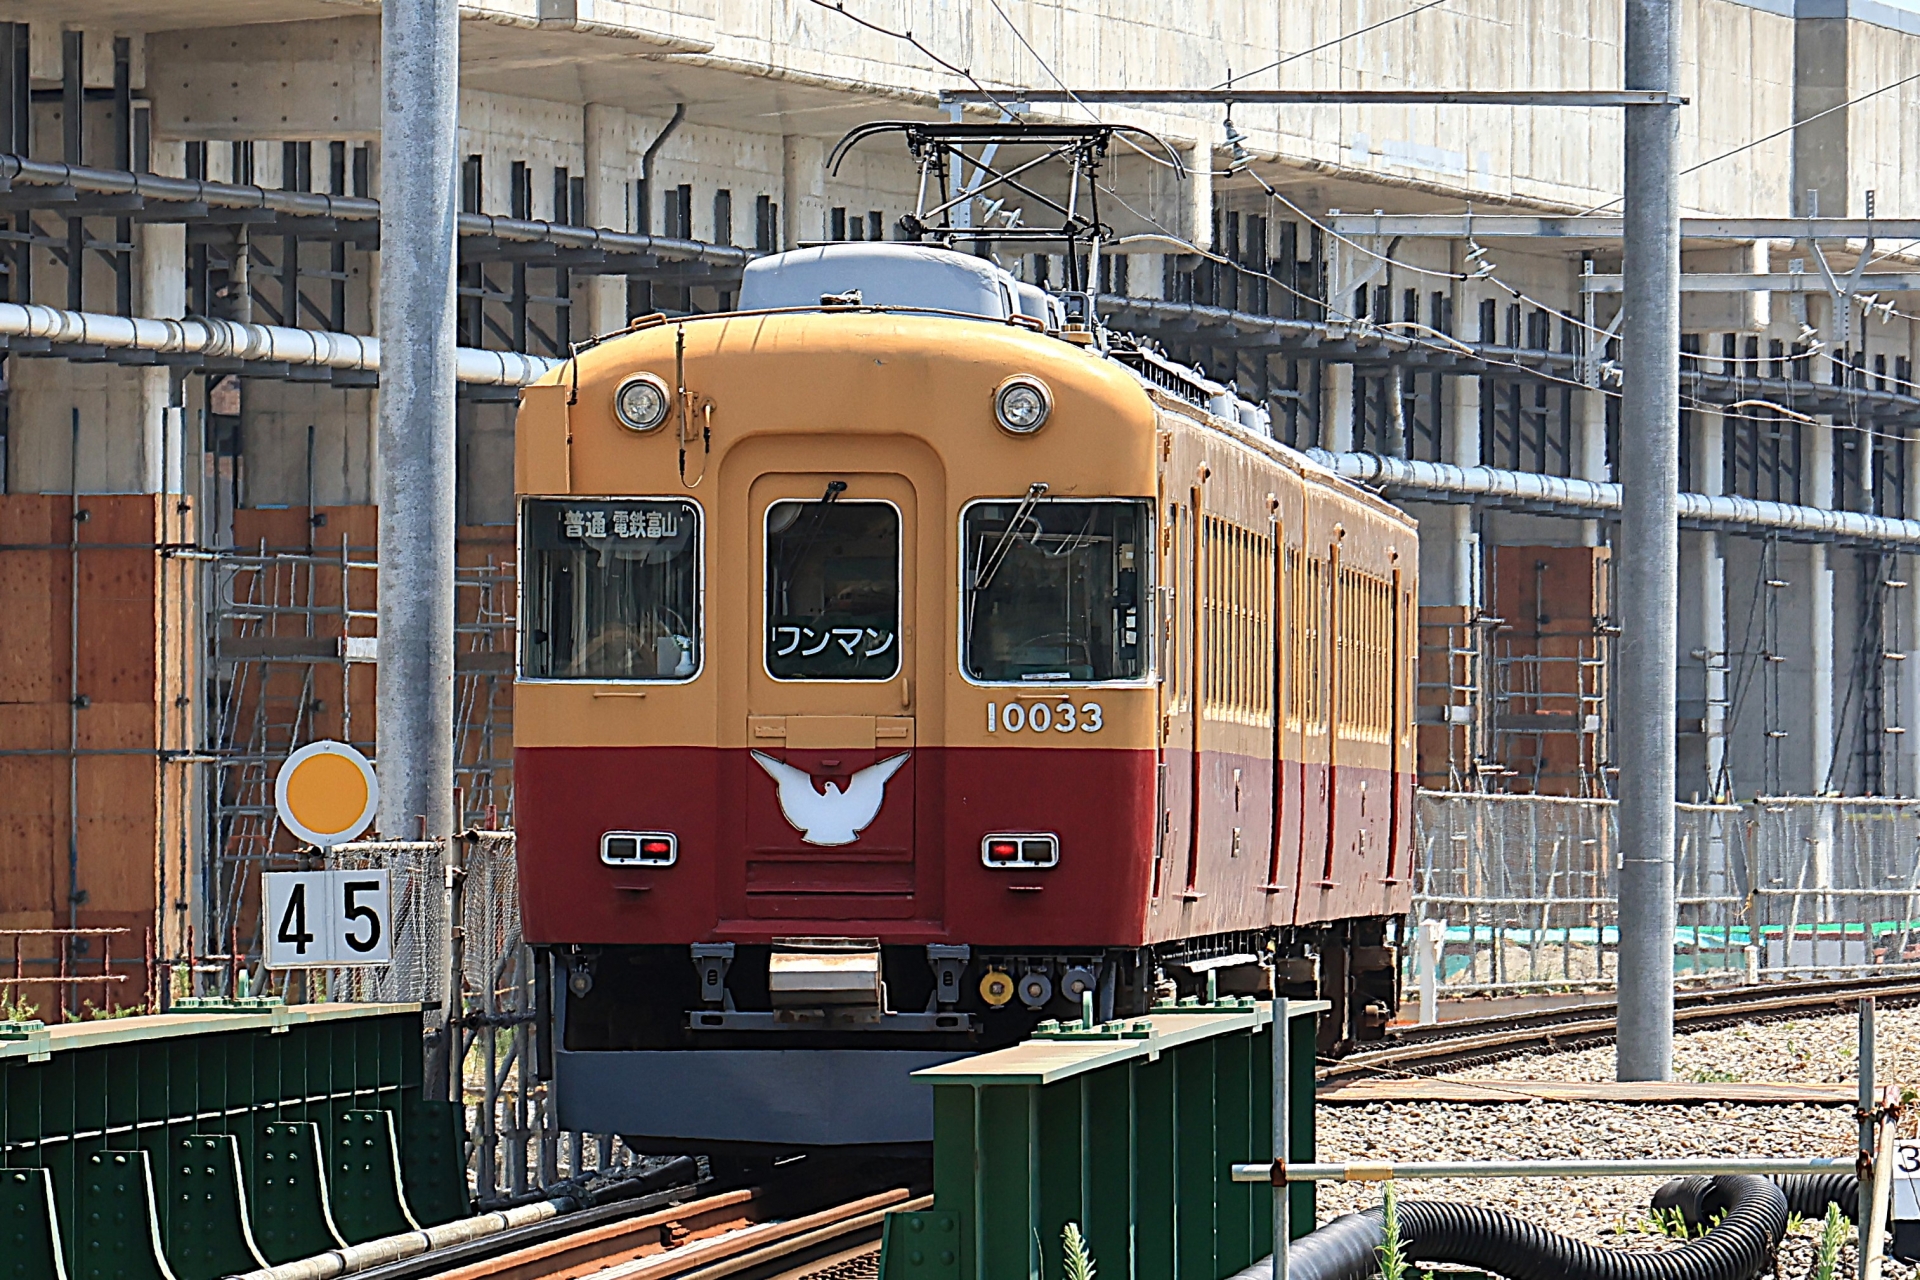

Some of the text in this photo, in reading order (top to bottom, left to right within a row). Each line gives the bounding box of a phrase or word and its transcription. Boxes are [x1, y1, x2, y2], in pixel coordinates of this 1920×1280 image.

[564, 510, 678, 538] 普通 電鉄富山
[771, 626, 894, 657] ワンマン
[987, 702, 1103, 732] 10033
